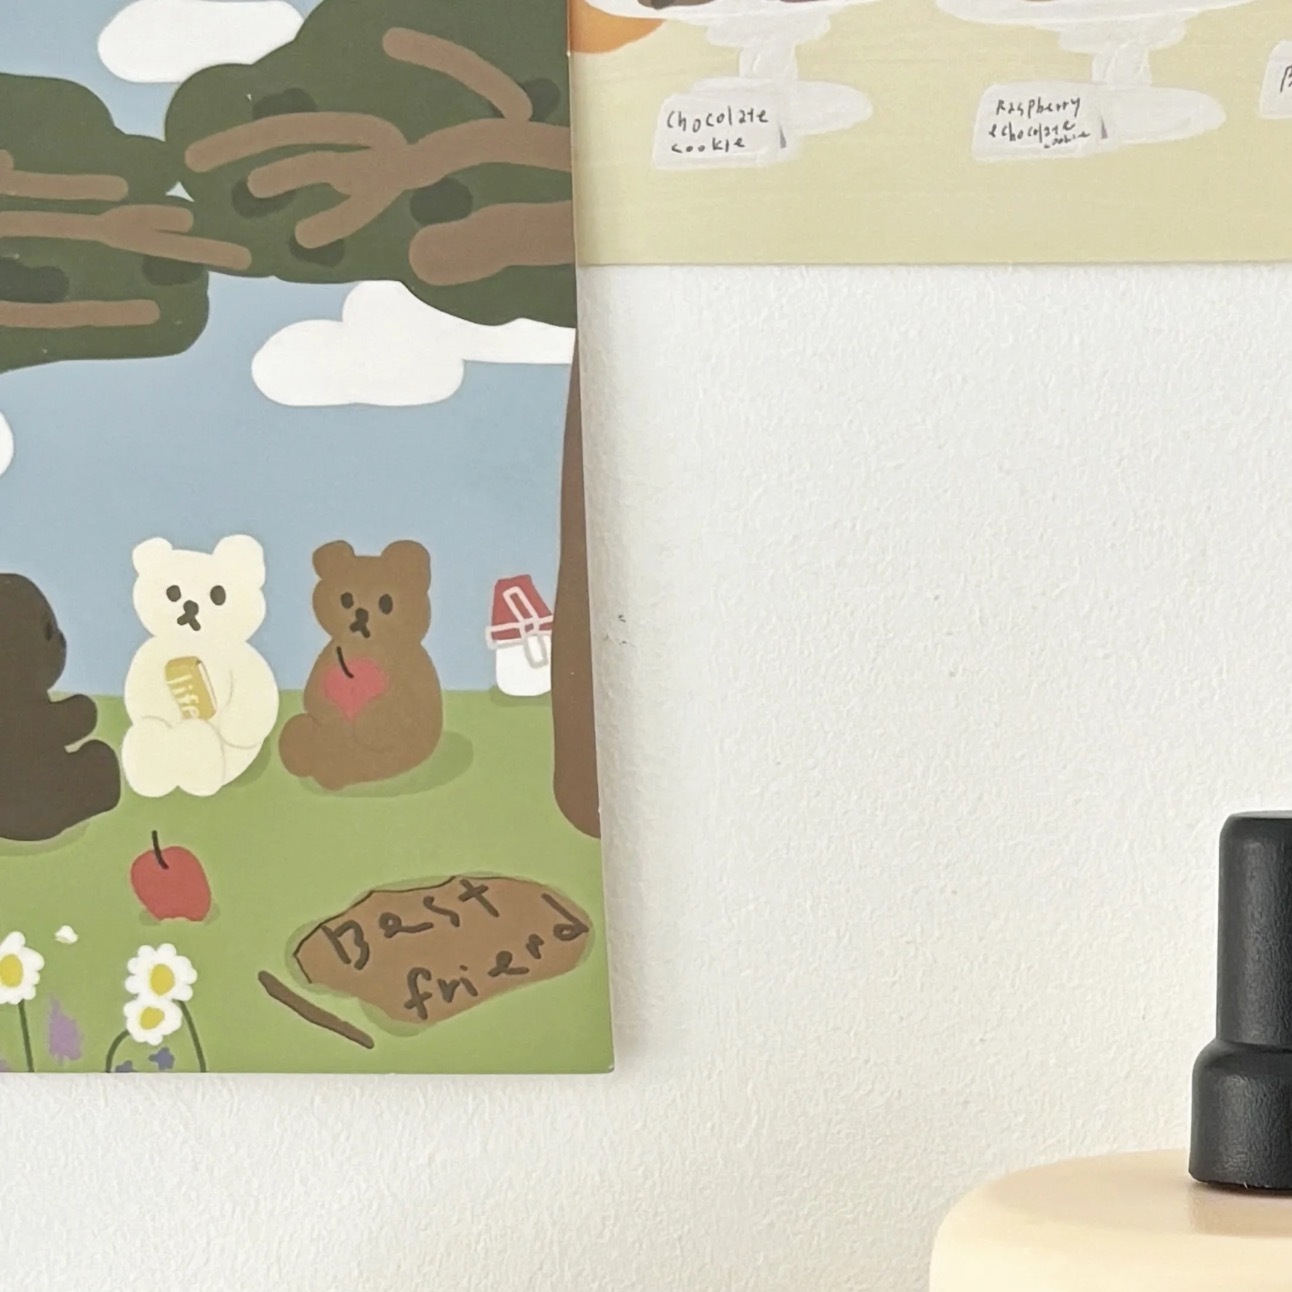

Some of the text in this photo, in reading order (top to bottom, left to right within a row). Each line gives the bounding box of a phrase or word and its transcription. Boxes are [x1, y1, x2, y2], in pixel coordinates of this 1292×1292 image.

[670, 137, 745, 153] cookie
[318, 878, 499, 970] Best
[403, 893, 590, 1020] friend
